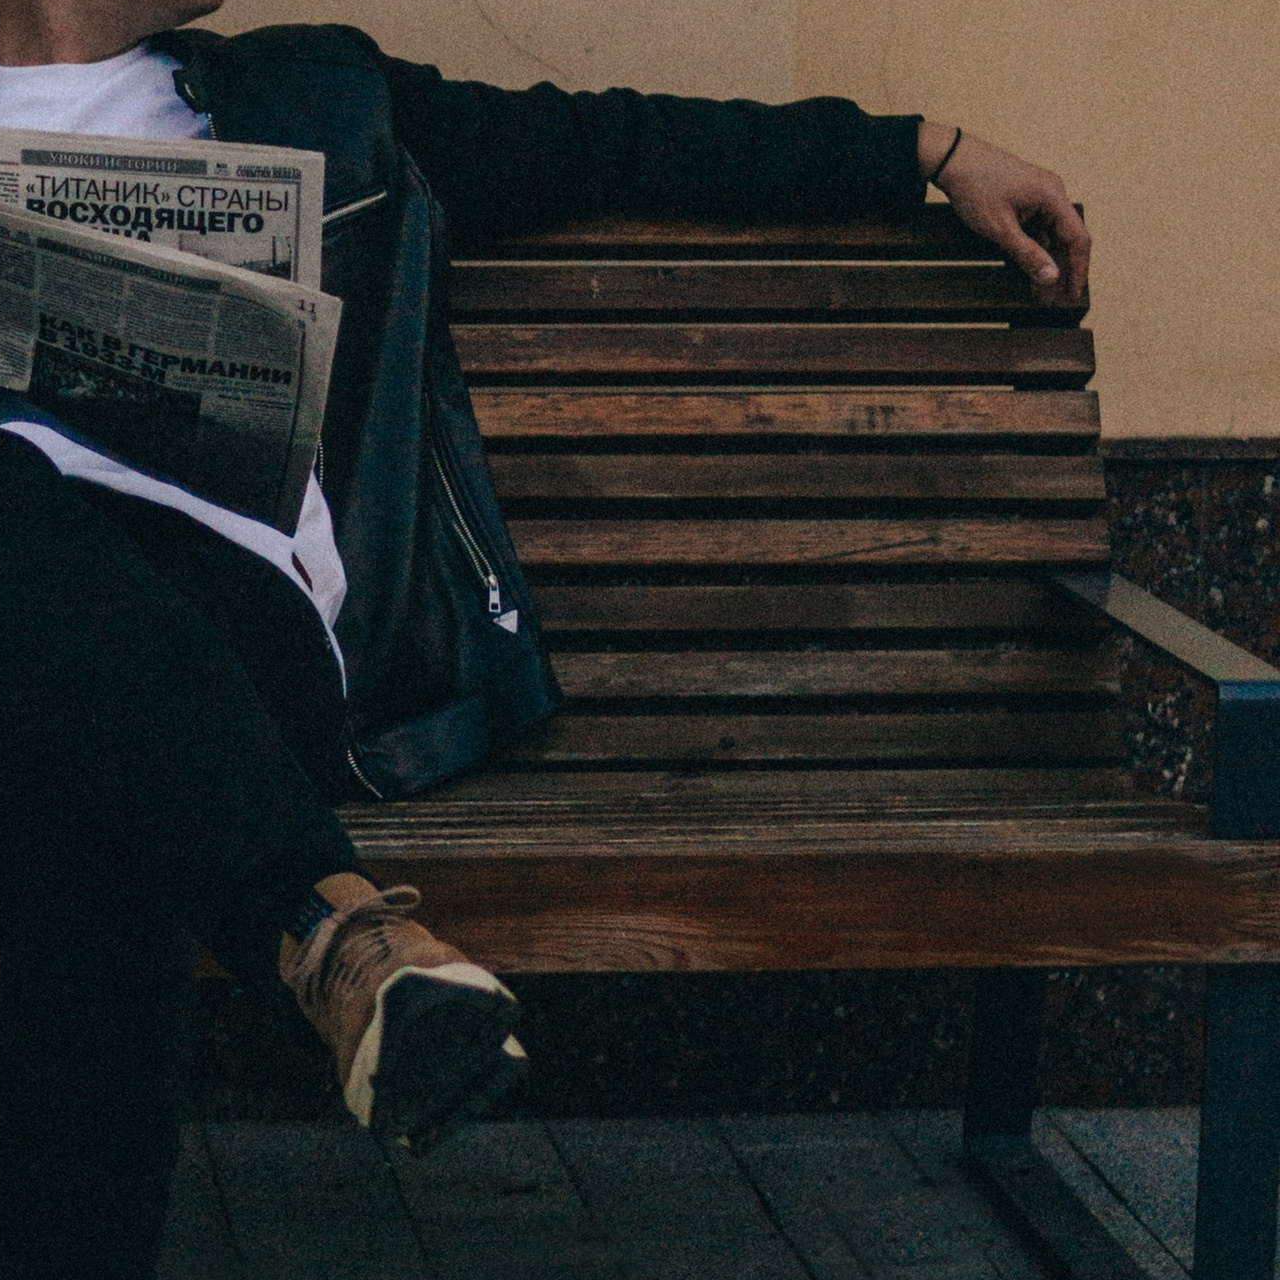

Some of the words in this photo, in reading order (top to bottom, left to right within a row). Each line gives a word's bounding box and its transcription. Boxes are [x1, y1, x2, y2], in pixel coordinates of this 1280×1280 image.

[48, 152, 100, 167] УРОКИ
[104, 156, 177, 173] ИСТОРИИ
[26, 174, 171, 205] «ТИТАНИК»
[177, 185, 289, 212] СТРАНЫ
[26, 198, 265, 235] ВОСХОДЯЩЕГО
[129, 342, 293, 386] ГЕРМАНИИ
